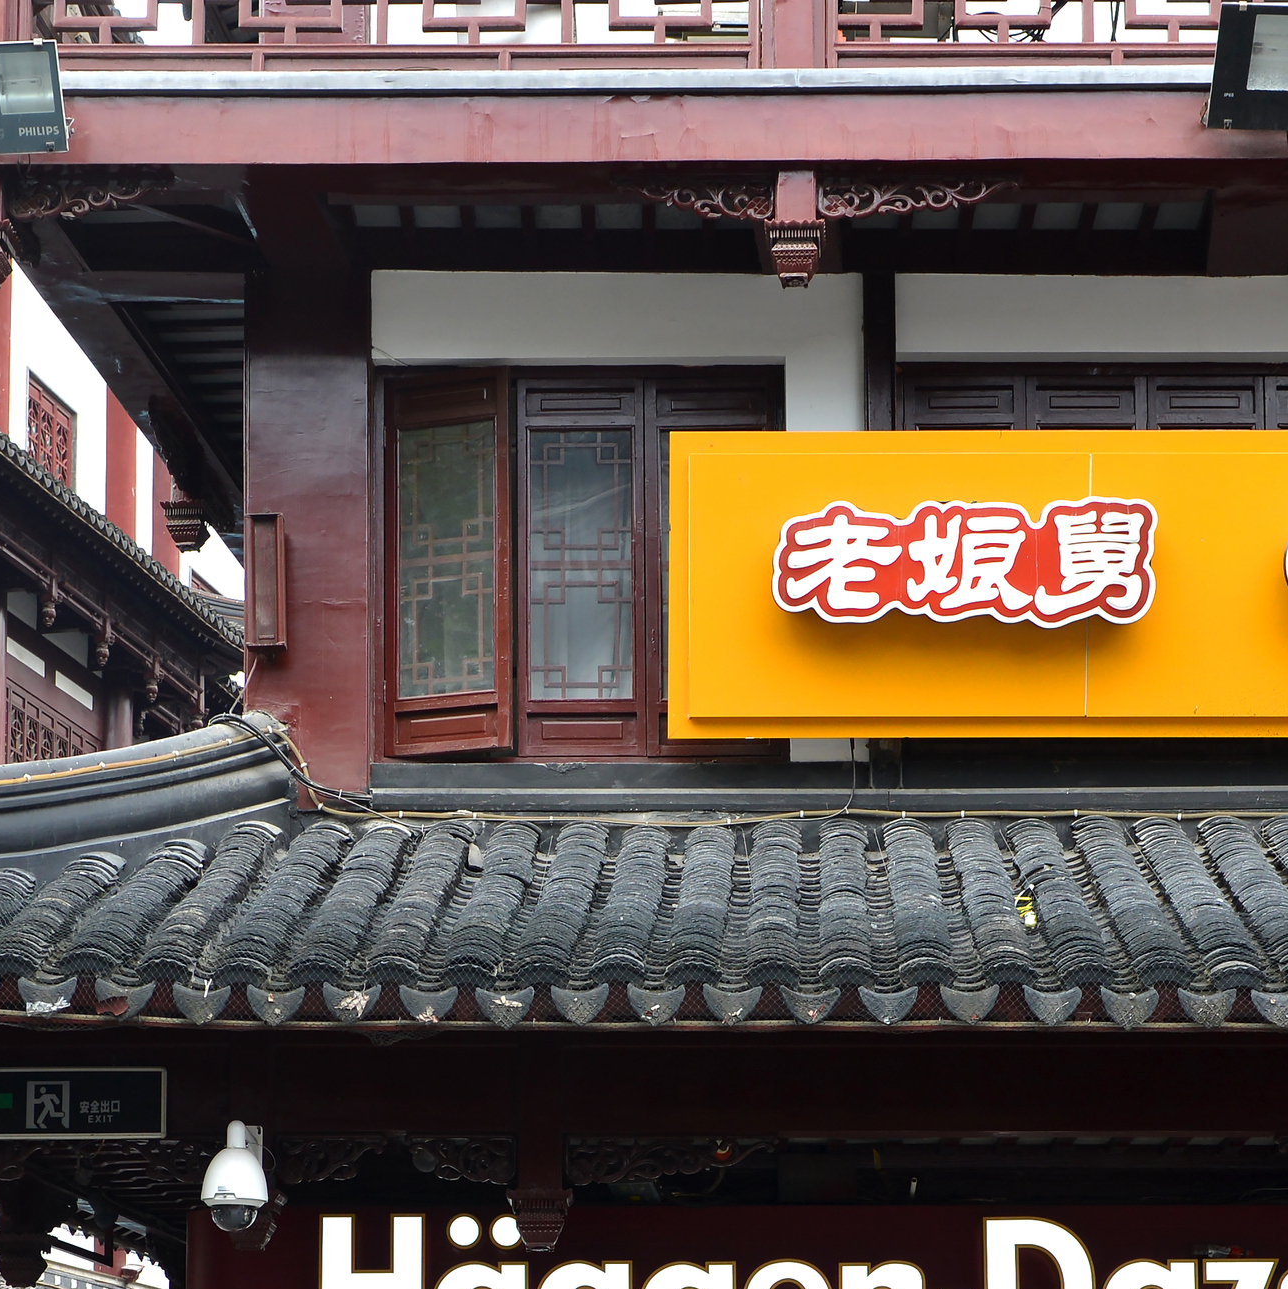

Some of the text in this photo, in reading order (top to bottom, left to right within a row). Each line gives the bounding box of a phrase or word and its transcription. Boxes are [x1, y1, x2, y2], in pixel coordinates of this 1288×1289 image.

[18, 126, 59, 136] PHILIPS
[783, 508, 1147, 620] 老娘舅
[79, 1101, 120, 1114] 安全出口
[88, 1115, 113, 1123] EXIT
